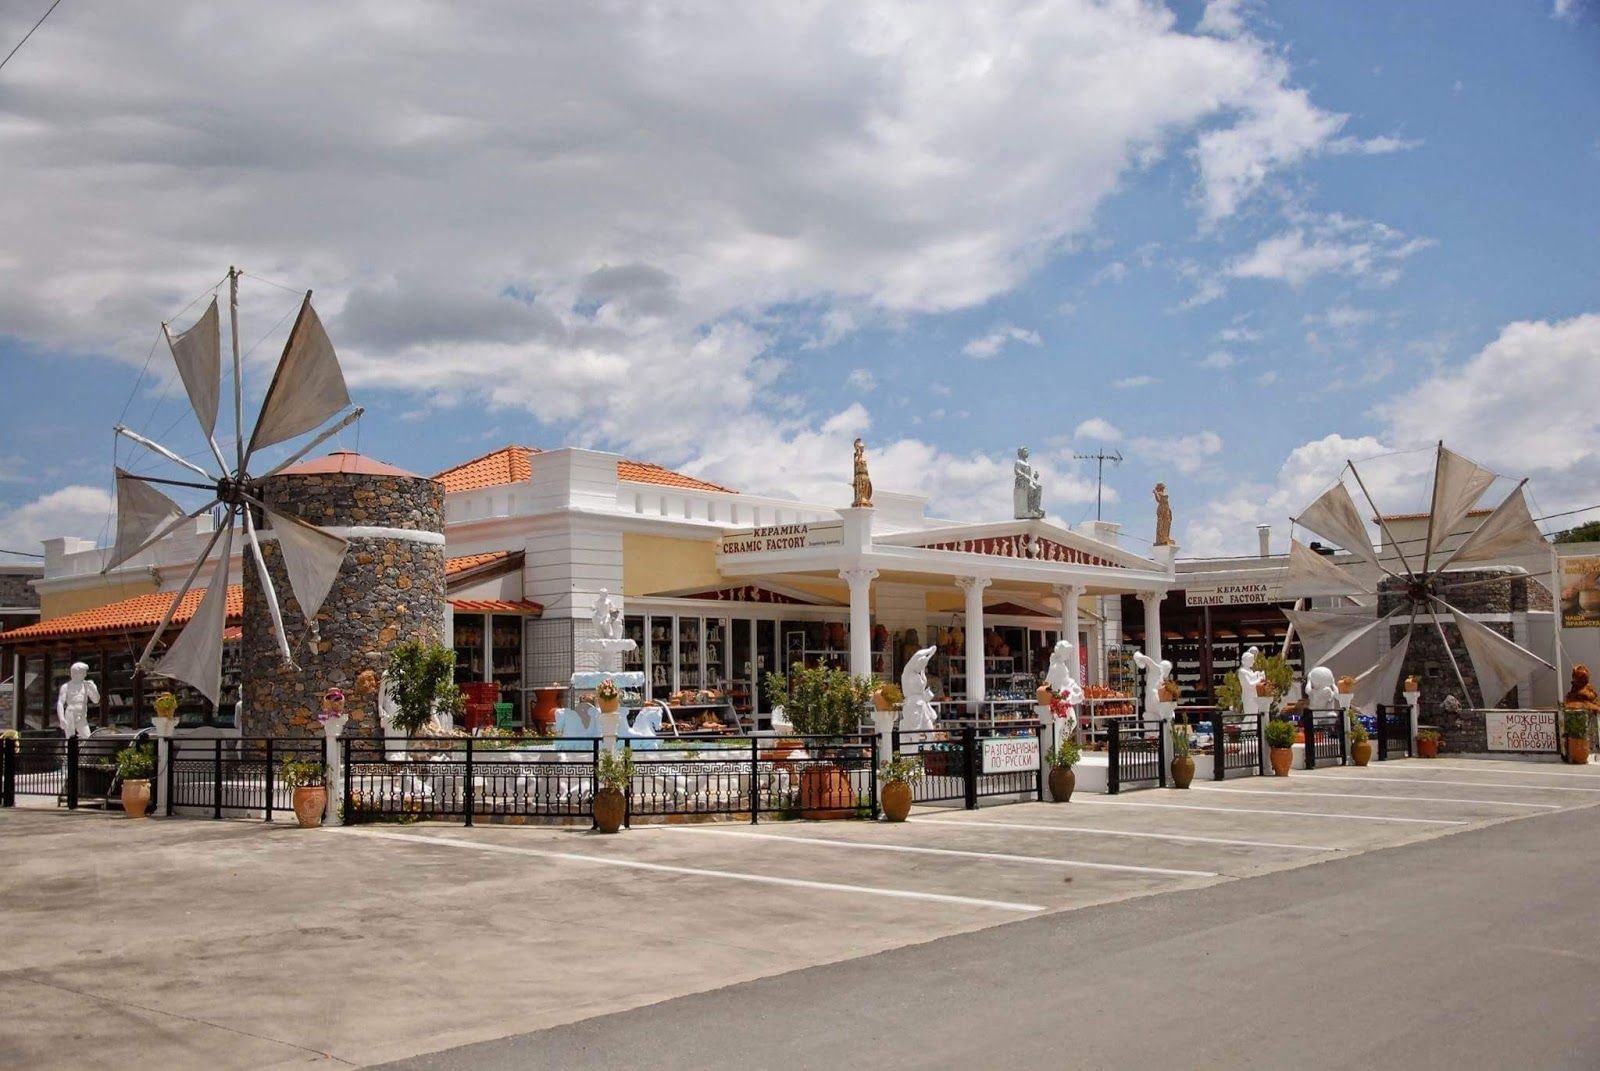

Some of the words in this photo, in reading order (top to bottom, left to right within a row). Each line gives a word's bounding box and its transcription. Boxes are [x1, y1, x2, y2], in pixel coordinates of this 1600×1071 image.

[723, 540, 762, 554] CERAMIC
[766, 536, 806, 550] FACTORY
[1187, 595, 1224, 605] CERAMIC
[1230, 593, 1266, 603] FACTORY
[1520, 723, 1542, 732] ЭТО
[991, 755, 1032, 768] ПО-РУССКИ
